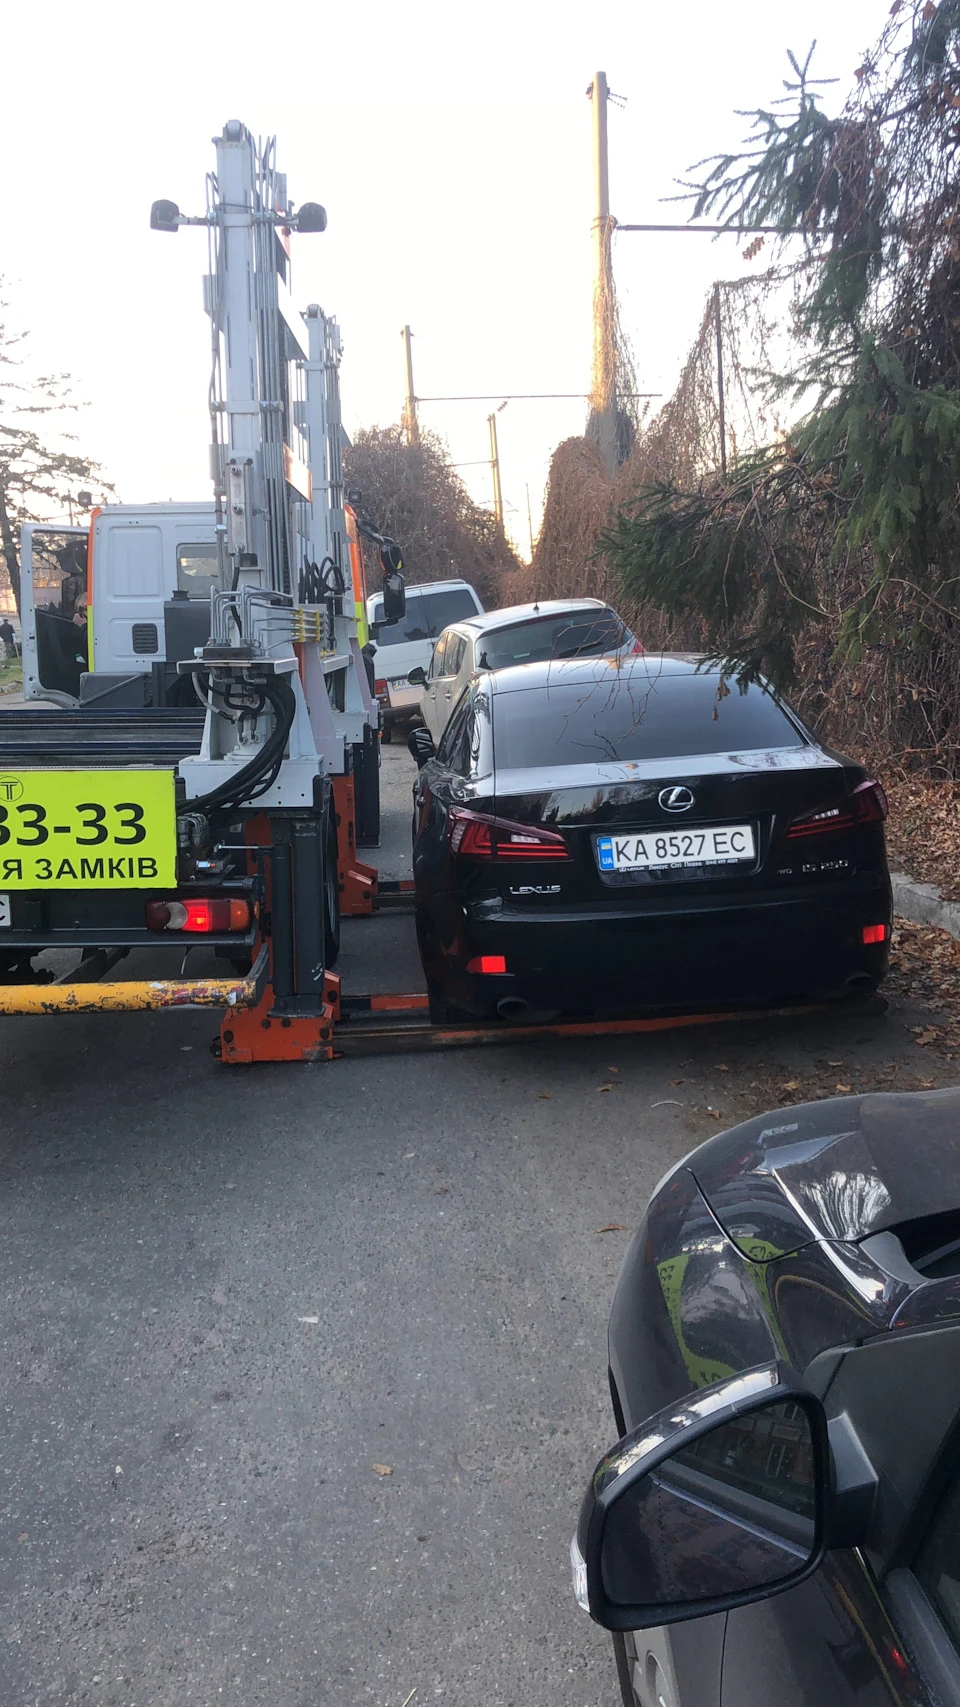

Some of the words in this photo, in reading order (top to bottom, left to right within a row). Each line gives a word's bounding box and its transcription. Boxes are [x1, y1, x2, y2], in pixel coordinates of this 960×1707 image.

[615, 839, 650, 863] KA
[655, 834, 706, 859] 8527
[713, 831, 746, 854] EC
[35, 857, 158, 880] ЗАМКІВ
[602, 857, 613, 865] UA
[509, 884, 561, 895] LEXUS
